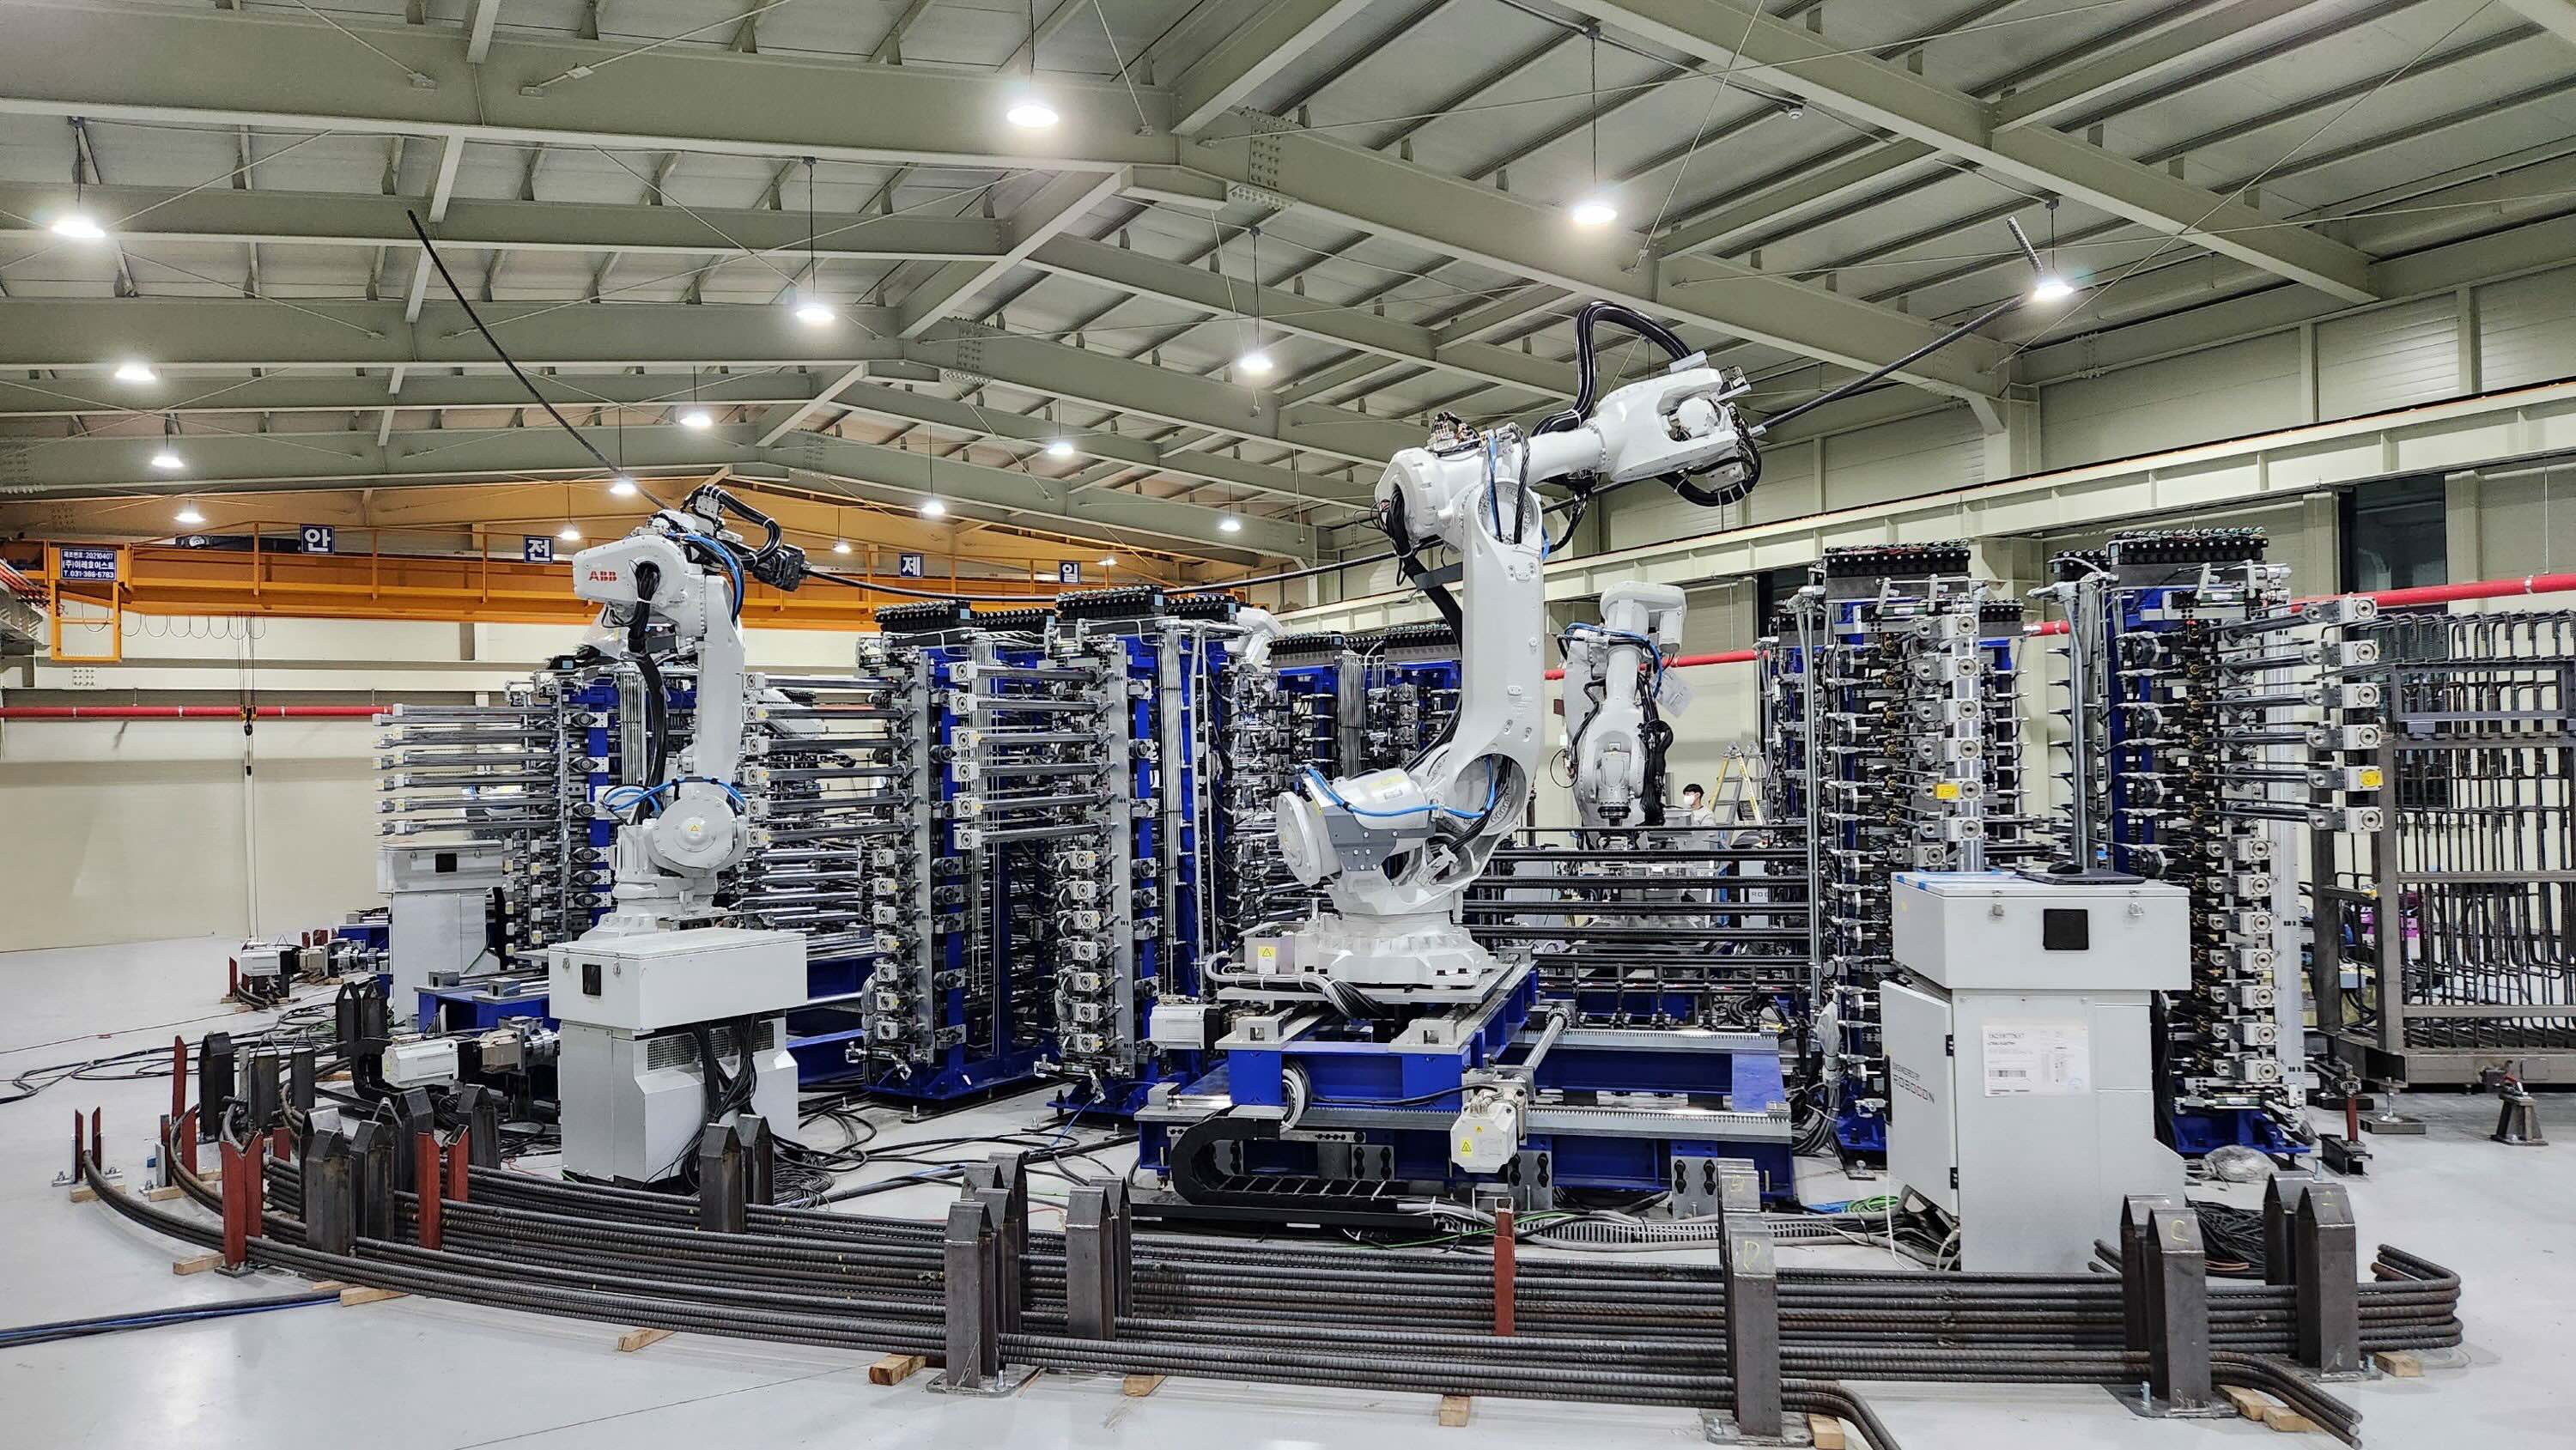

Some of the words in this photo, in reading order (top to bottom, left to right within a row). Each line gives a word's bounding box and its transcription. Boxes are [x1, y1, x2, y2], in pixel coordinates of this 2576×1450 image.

[304, 528, 331, 552] 안
[527, 539, 550, 561] 전
[589, 571, 617, 581] ABB
[902, 556, 920, 576] 제
[1062, 563, 1078, 583] 일
